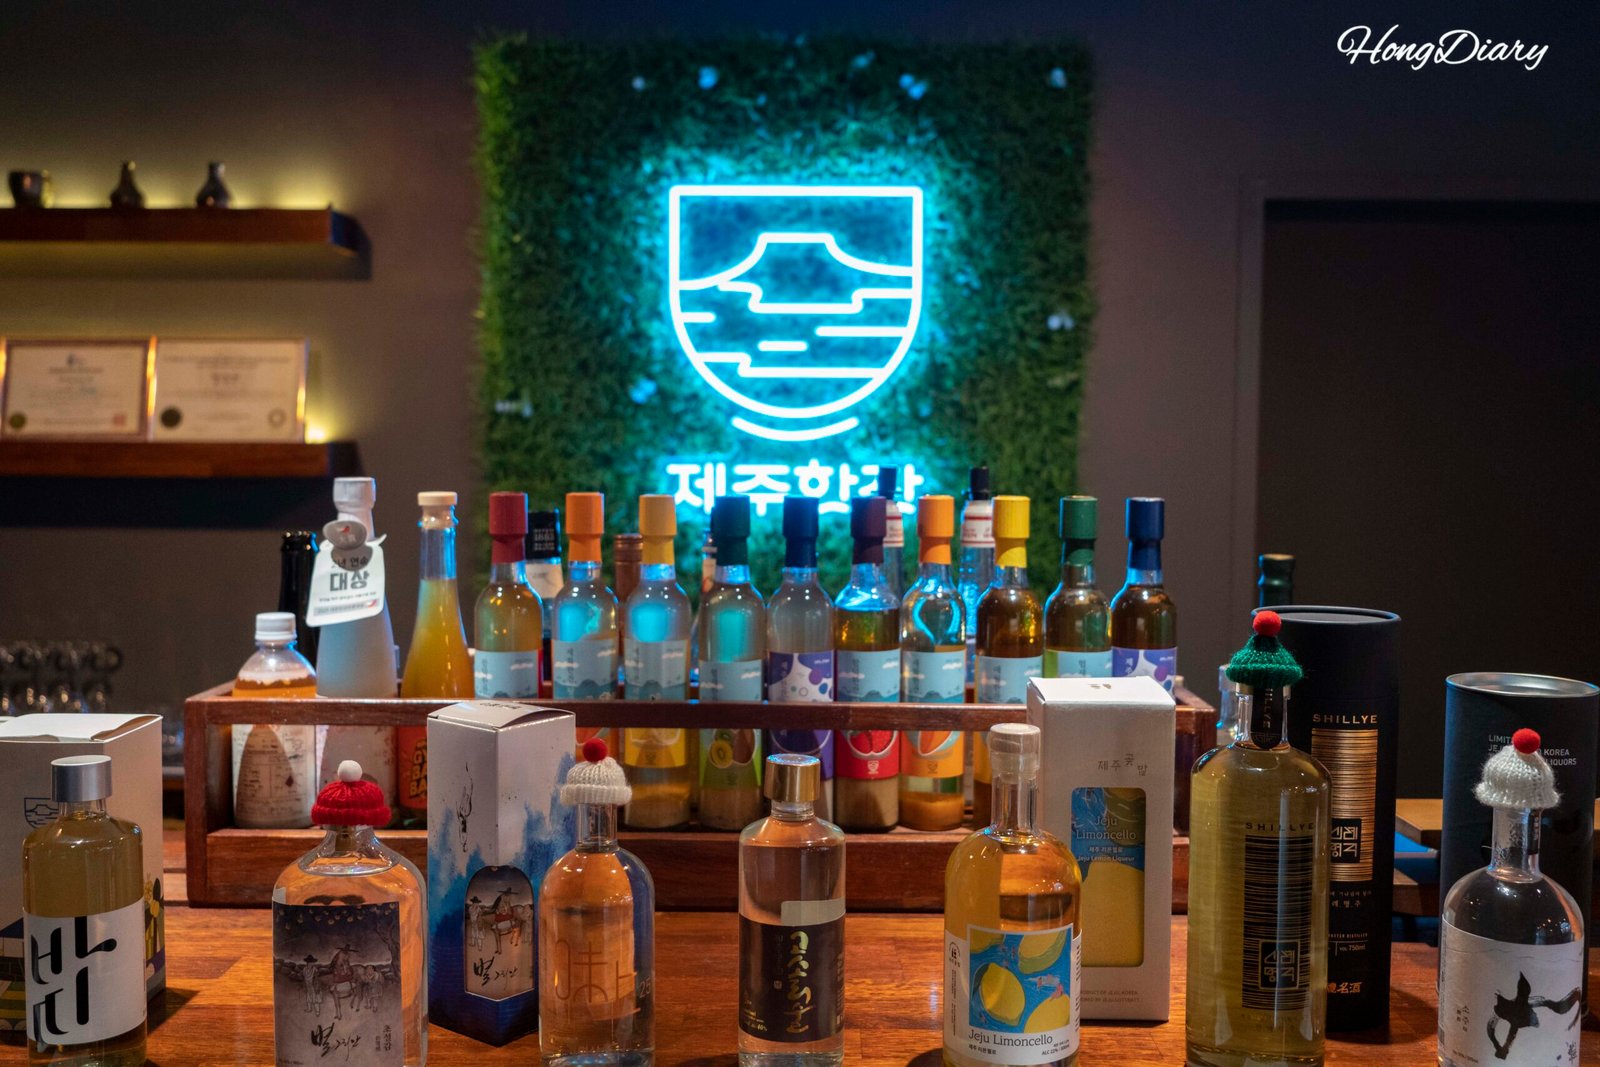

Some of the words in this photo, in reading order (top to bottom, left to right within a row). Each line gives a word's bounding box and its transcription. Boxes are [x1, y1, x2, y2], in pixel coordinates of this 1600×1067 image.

[329, 570, 370, 592] 대상
[1312, 713, 1378, 724] SHILLYE
[1543, 748, 1570, 756] KOREA
[1094, 815, 1118, 828] Jeju
[1076, 829, 1137, 840] Limoncello
[968, 1029, 990, 1044] Jeju
[993, 1033, 1053, 1047] Limoncello
